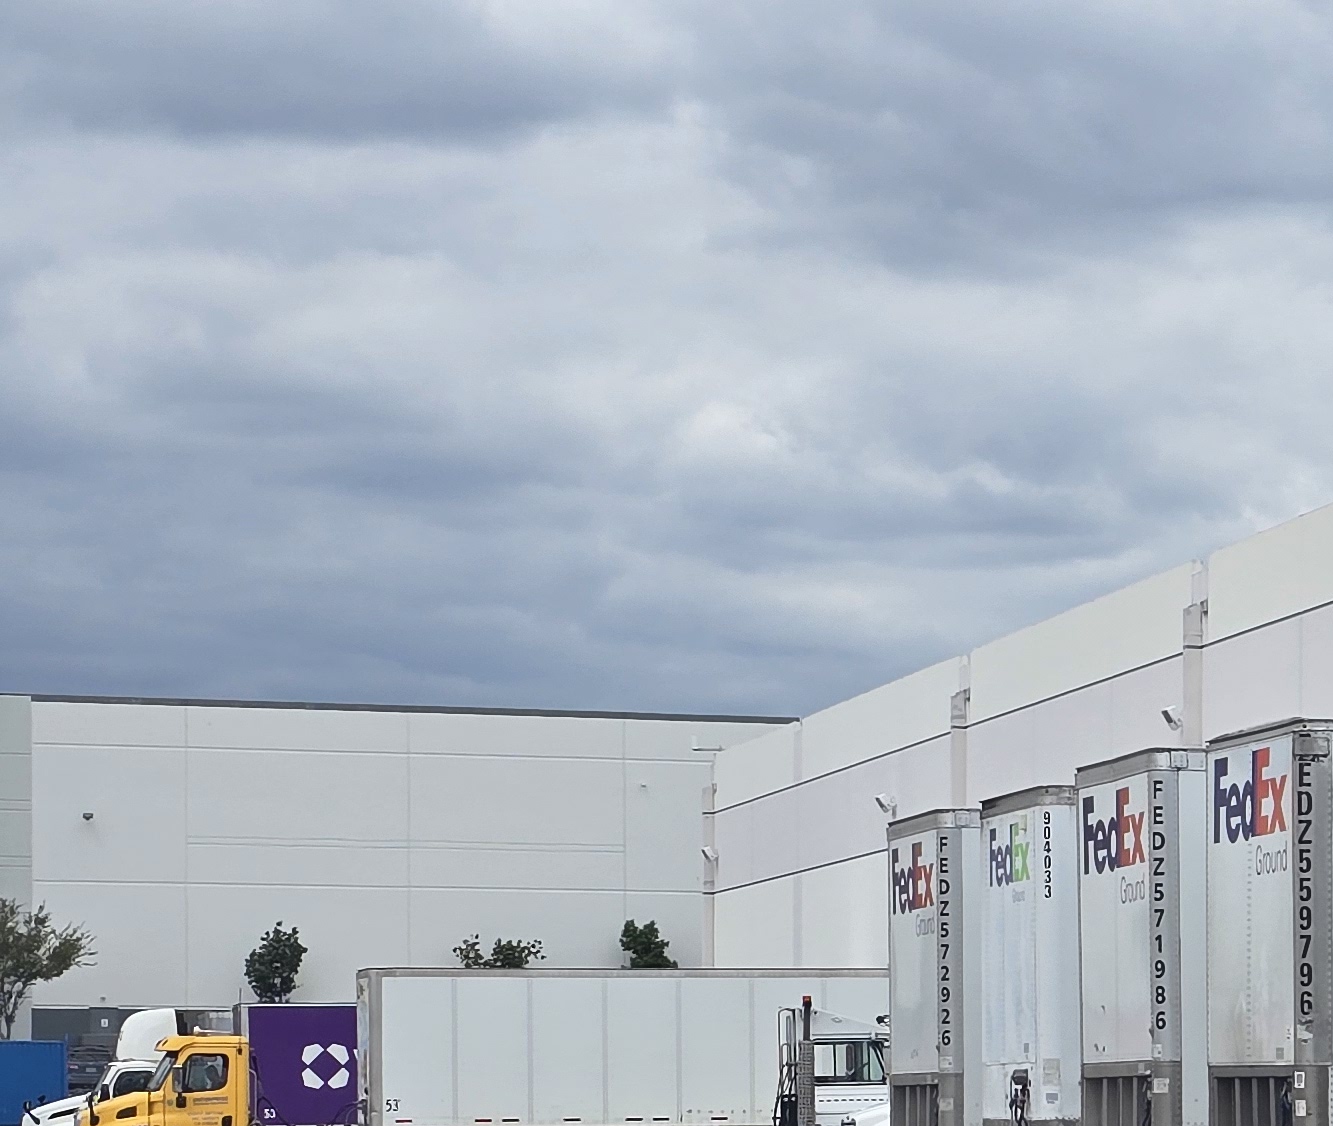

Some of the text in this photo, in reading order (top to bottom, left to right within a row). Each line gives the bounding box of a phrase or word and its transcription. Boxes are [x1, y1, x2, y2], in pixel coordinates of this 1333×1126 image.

[1082, 786, 1146, 875] FedEx
[1213, 746, 1288, 844] FedEx
[891, 841, 935, 915] FedEx
[989, 822, 1031, 888] FedEx
[1043, 811, 1052, 899] 904033
[1255, 840, 1288, 876] Ground
[1296, 733, 1313, 1016] EDZ559796
[938, 836, 951, 1046] FEDZ572926
[1152, 780, 1167, 1030] FEDZ571986
